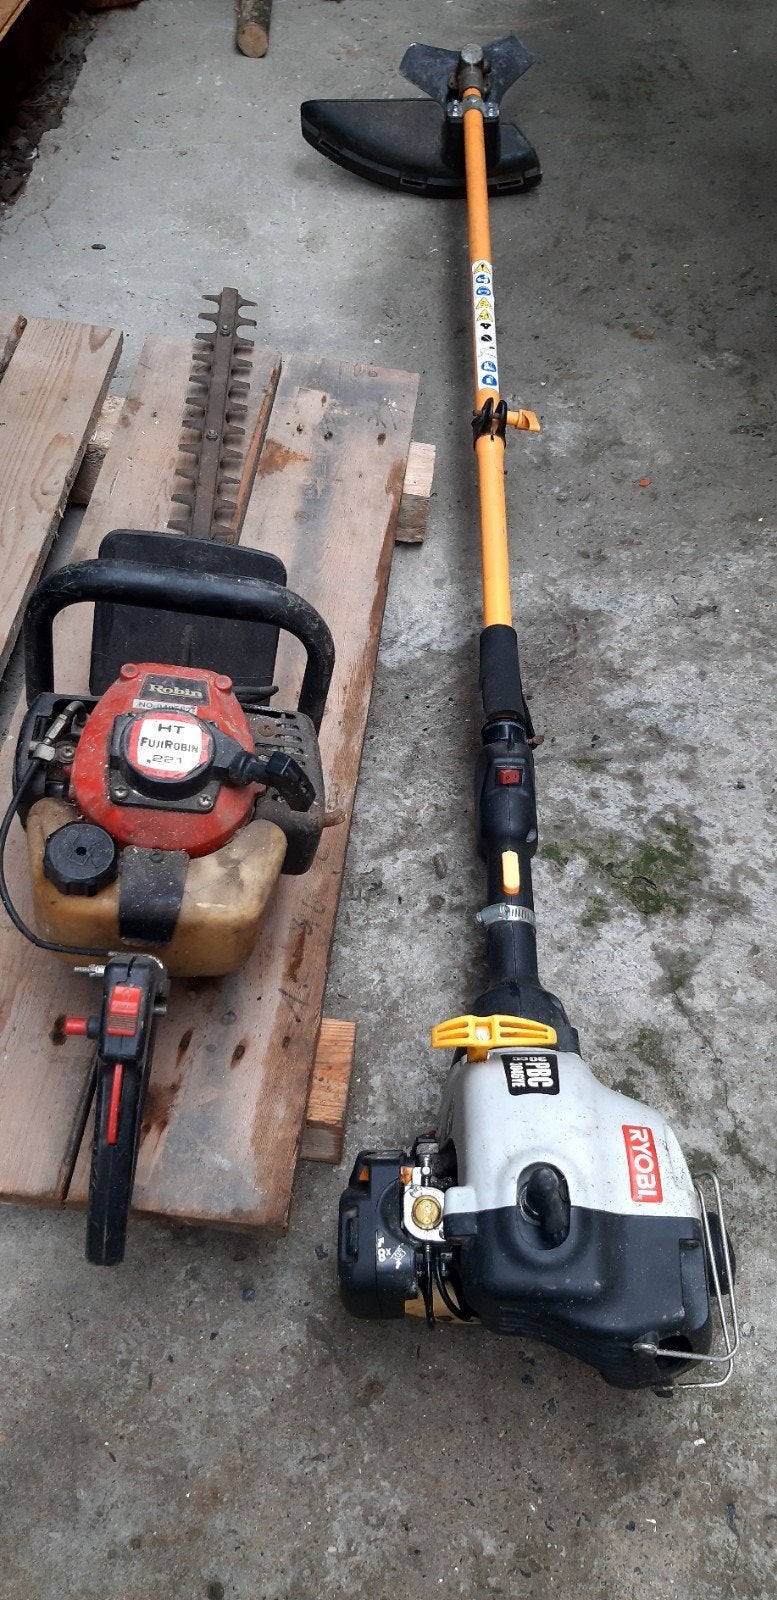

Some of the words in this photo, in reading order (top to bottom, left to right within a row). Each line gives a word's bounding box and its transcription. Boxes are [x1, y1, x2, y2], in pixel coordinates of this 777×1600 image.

[149, 684, 203, 699] Robin
[158, 723, 185, 734] HT
[525, 1062, 554, 1087] PBC
[629, 1128, 658, 1197] RYOBI
